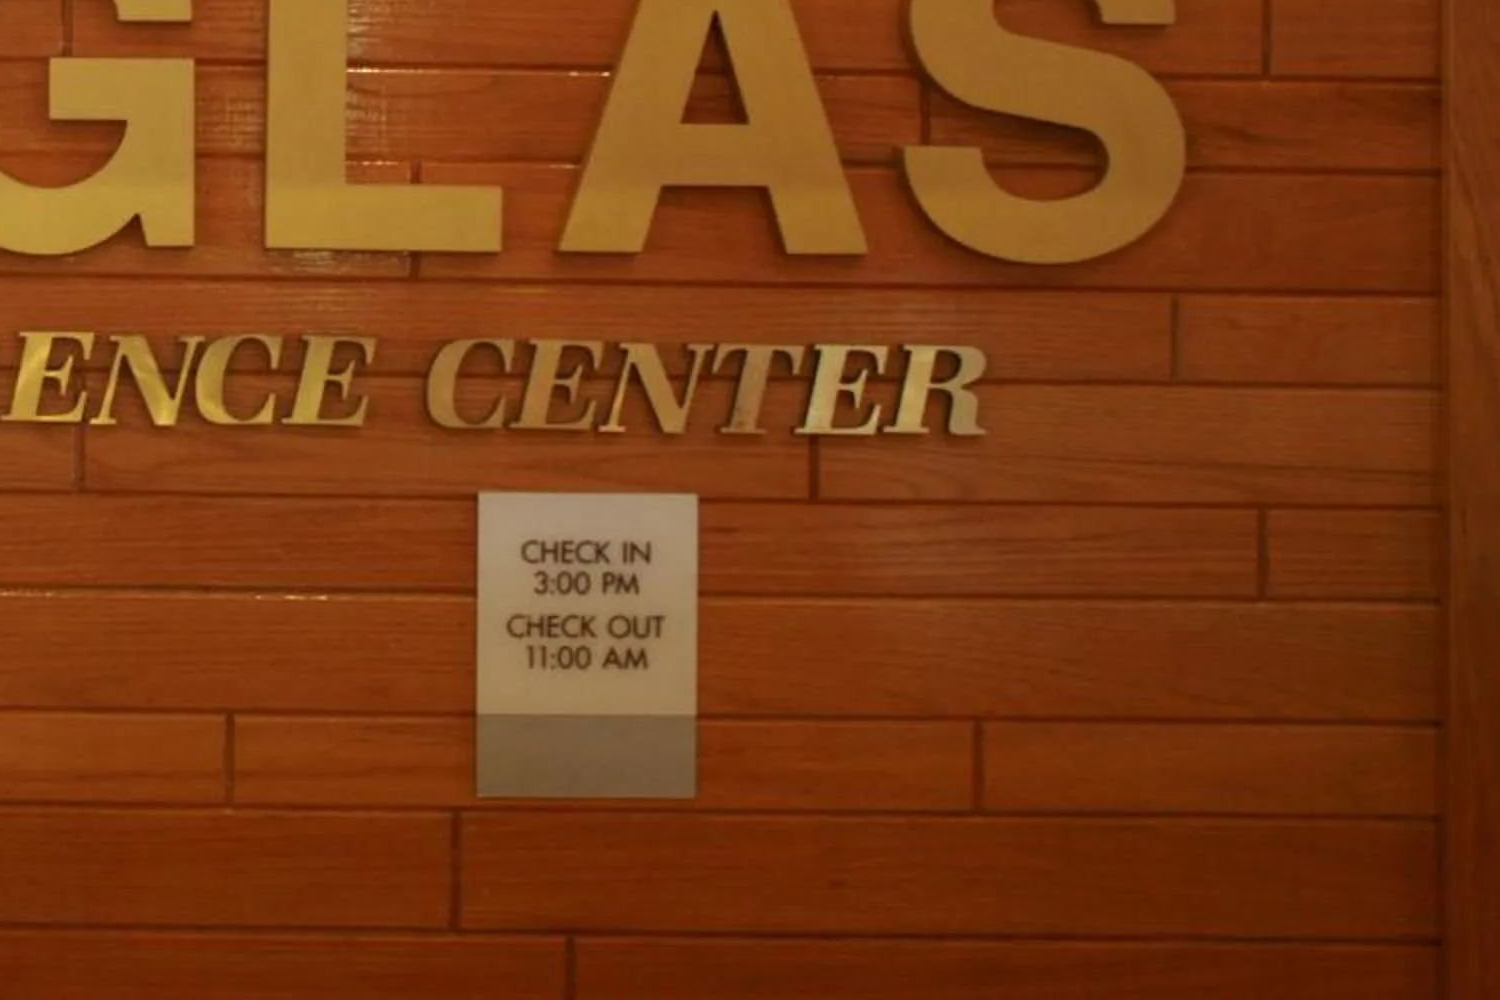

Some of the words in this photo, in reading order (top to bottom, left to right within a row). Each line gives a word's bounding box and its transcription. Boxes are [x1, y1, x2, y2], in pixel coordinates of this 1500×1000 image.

[426, 336, 989, 438] CENTER
[520, 539, 610, 565] CHECK
[622, 541, 652, 565] IN
[533, 571, 591, 596] 3:00
[602, 572, 640, 595] PM
[506, 613, 597, 639] CHECK
[607, 614, 666, 639] OUT
[526, 645, 592, 671] 11:00
[602, 647, 648, 670] AM
